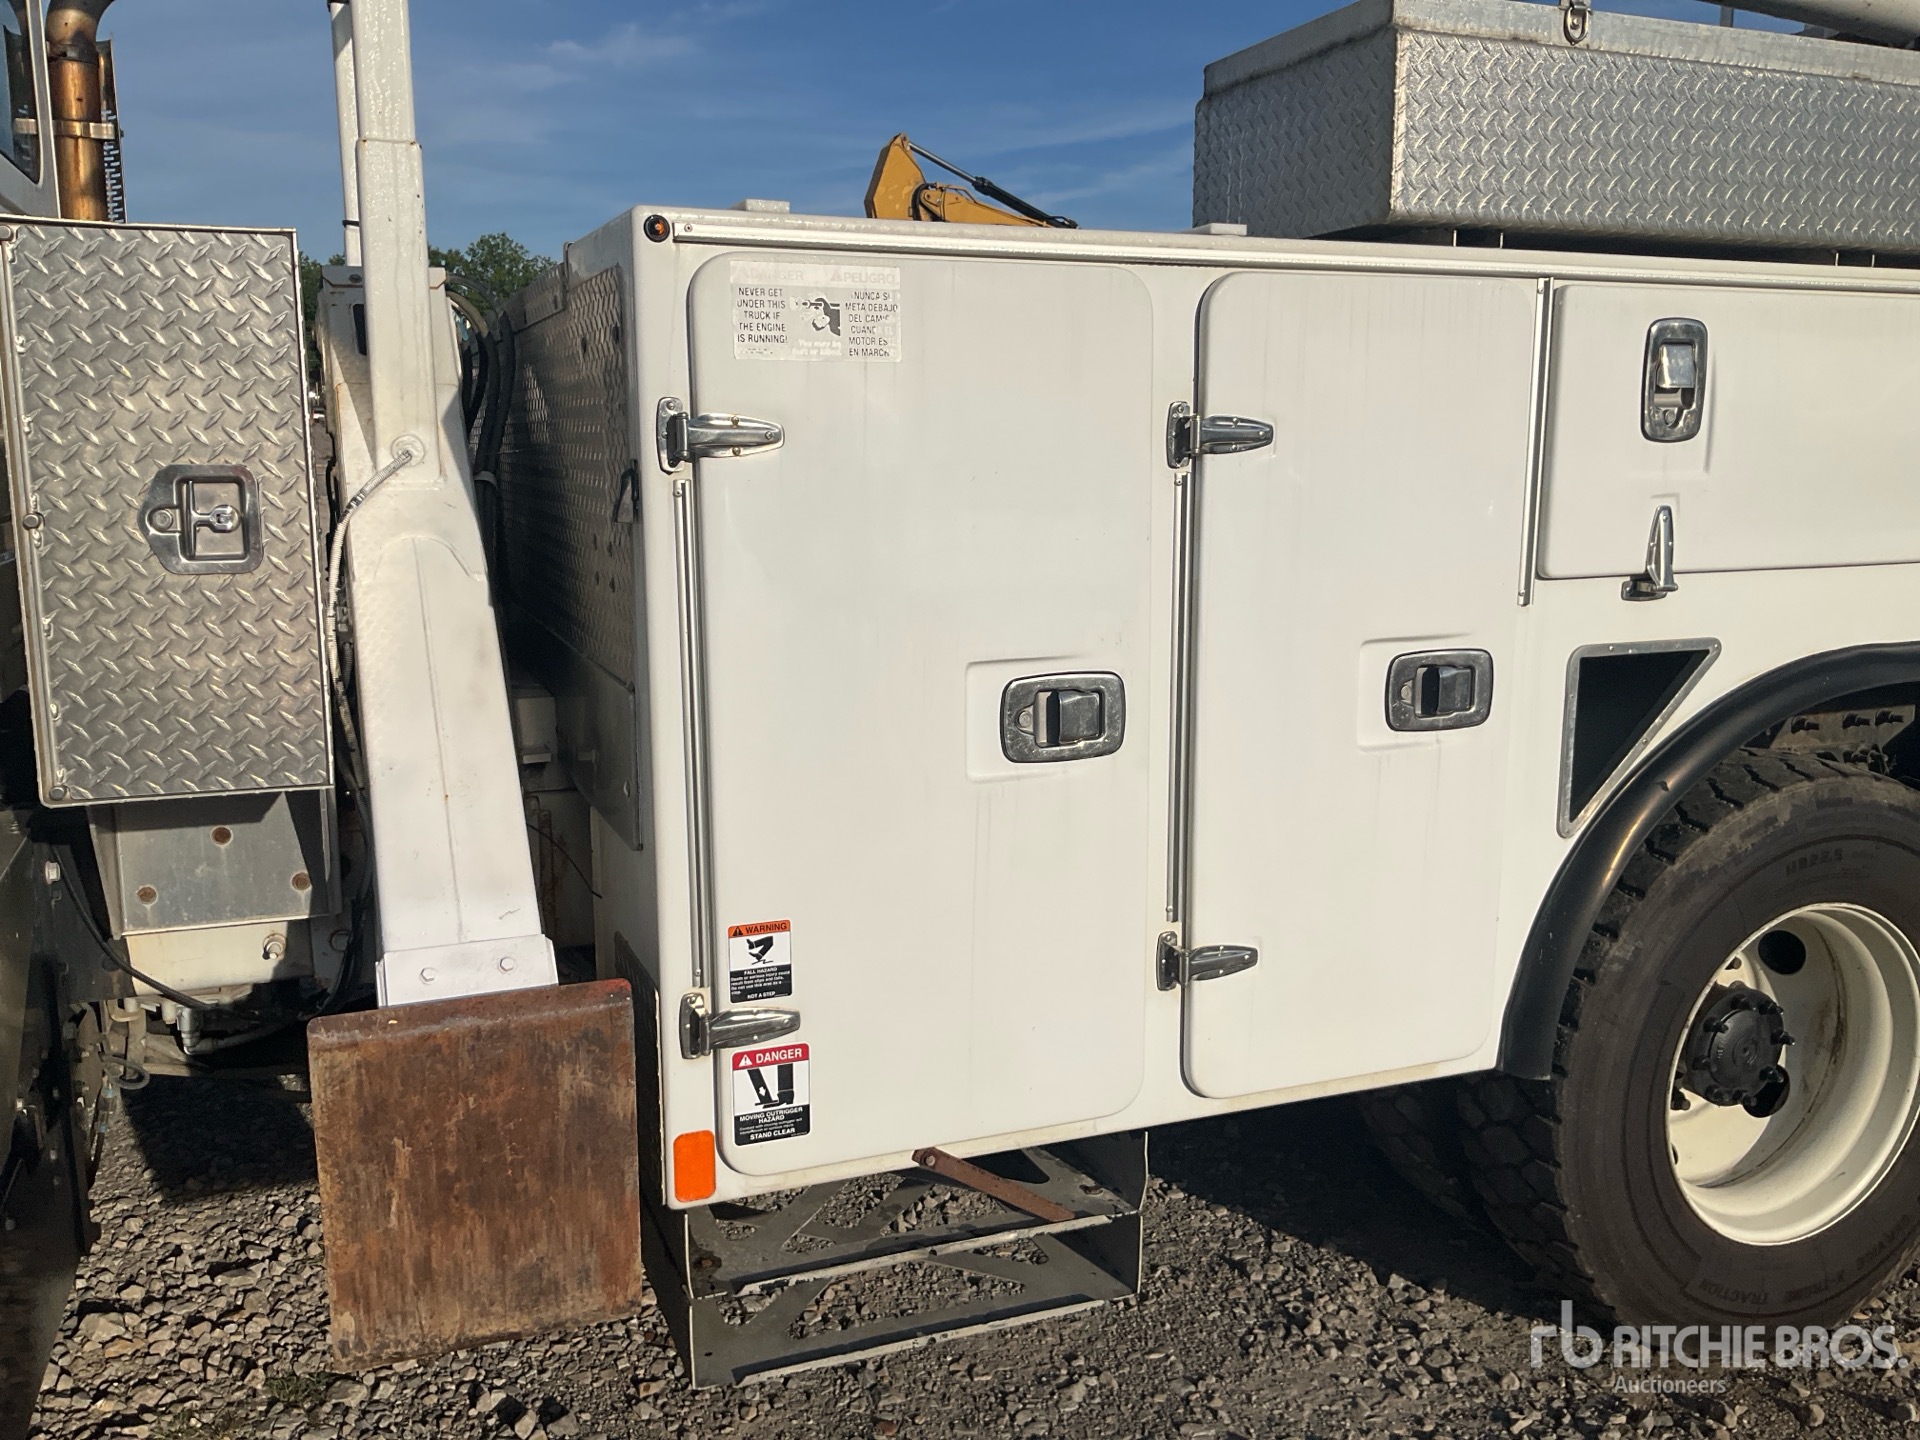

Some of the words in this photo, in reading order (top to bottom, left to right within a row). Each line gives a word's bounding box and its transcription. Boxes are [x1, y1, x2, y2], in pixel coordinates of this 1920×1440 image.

[750, 270, 804, 281] DANGER
[844, 272, 895, 284] PELIGRO
[738, 288, 766, 297] NEVER
[768, 288, 783, 297] GET
[737, 299, 765, 308] UNDER
[767, 300, 786, 309] THIS
[845, 302, 866, 311] META
[868, 303, 898, 312] DEBAJO
[744, 310, 771, 320] TRUCK
[773, 311, 781, 320] IF
[848, 314, 862, 322] DEL
[739, 322, 754, 332] THE
[756, 323, 786, 332] ENGINE
[737, 334, 746, 342] IS
[748, 334, 788, 344] RUNNING!
[849, 337, 876, 345] MOTOR
[849, 348, 859, 356] EN
[745, 922, 787, 934] WARNING
[756, 1048, 802, 1064] DANGER
[740, 1113, 765, 1122] MOVING
[766, 1107, 803, 1117] OUTRIGGER
[758, 1115, 785, 1124] HAZARD
[750, 1131, 772, 1140] STAND
[773, 1127, 796, 1136] CLEAR
[1698, 1279, 1769, 1305] TRACTION
